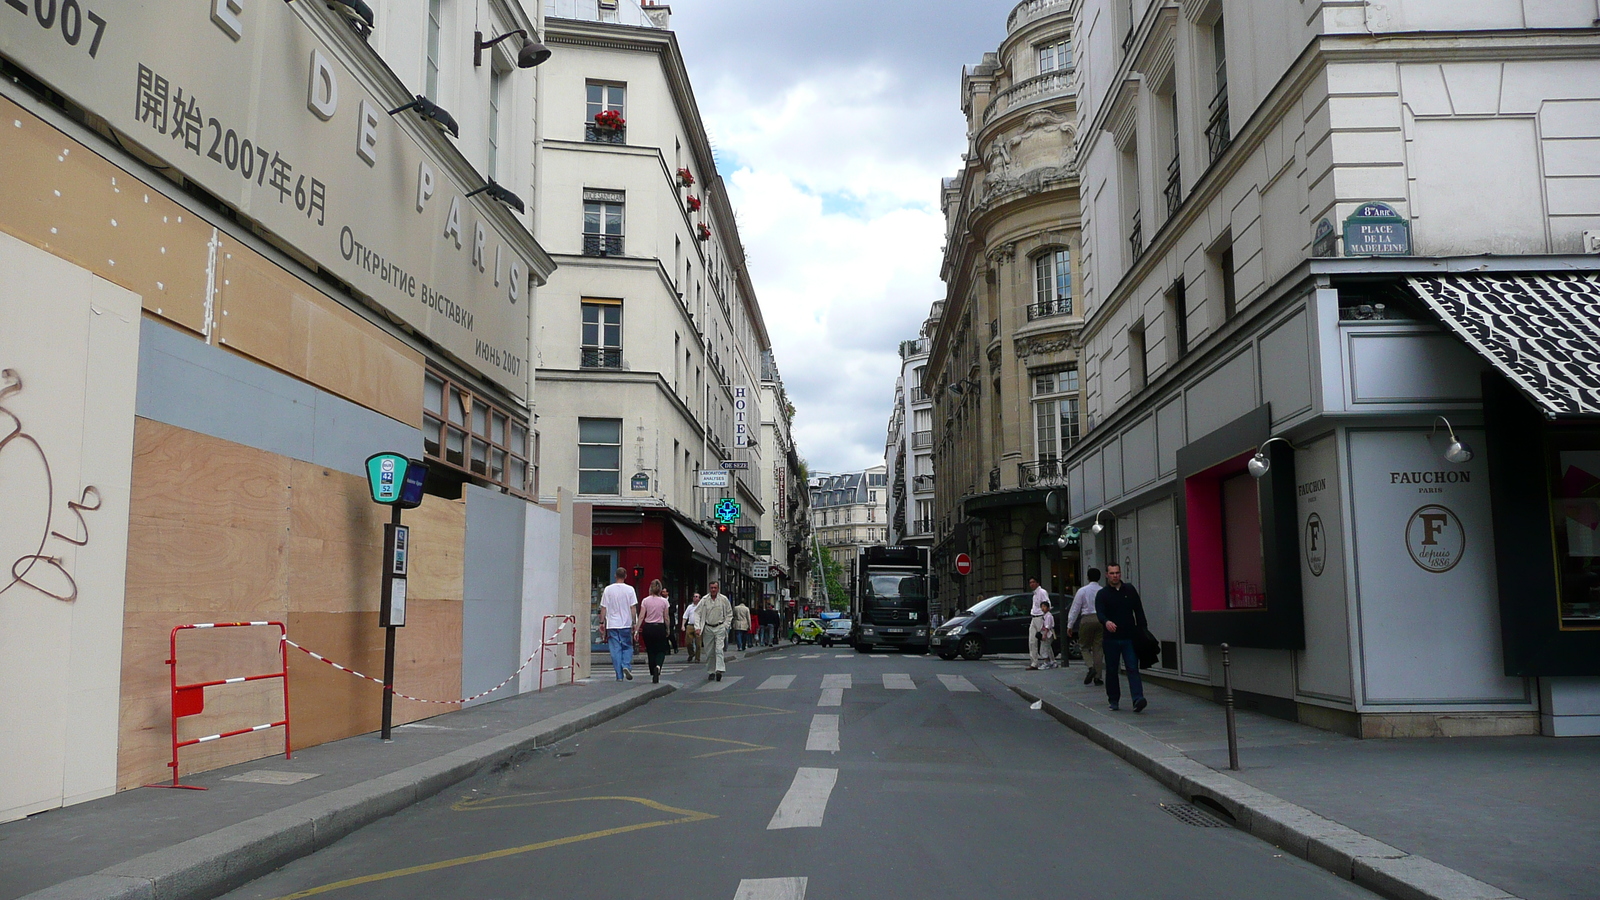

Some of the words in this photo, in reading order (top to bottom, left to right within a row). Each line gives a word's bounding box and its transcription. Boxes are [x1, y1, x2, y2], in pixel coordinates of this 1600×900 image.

[306, 48, 379, 168] DE
[416, 160, 519, 305] PARIS
[1361, 225, 1393, 234] PLACE
[1364, 235, 1377, 243] DE
[1379, 235, 1392, 243] LA
[1350, 244, 1405, 253] MADELEINE
[340, 225, 416, 298] Открытие
[475, 338, 501, 367] июнь
[502, 350, 521, 378] 2007
[735, 387, 746, 446] HOTEL
[1390, 470, 1471, 484] FAUCHON
[1298, 478, 1326, 497] FAUCHON
[1309, 521, 1320, 552] F
[1418, 513, 1448, 546] F
[1419, 545, 1451, 563] depuis
[1430, 557, 1450, 567] 1886
